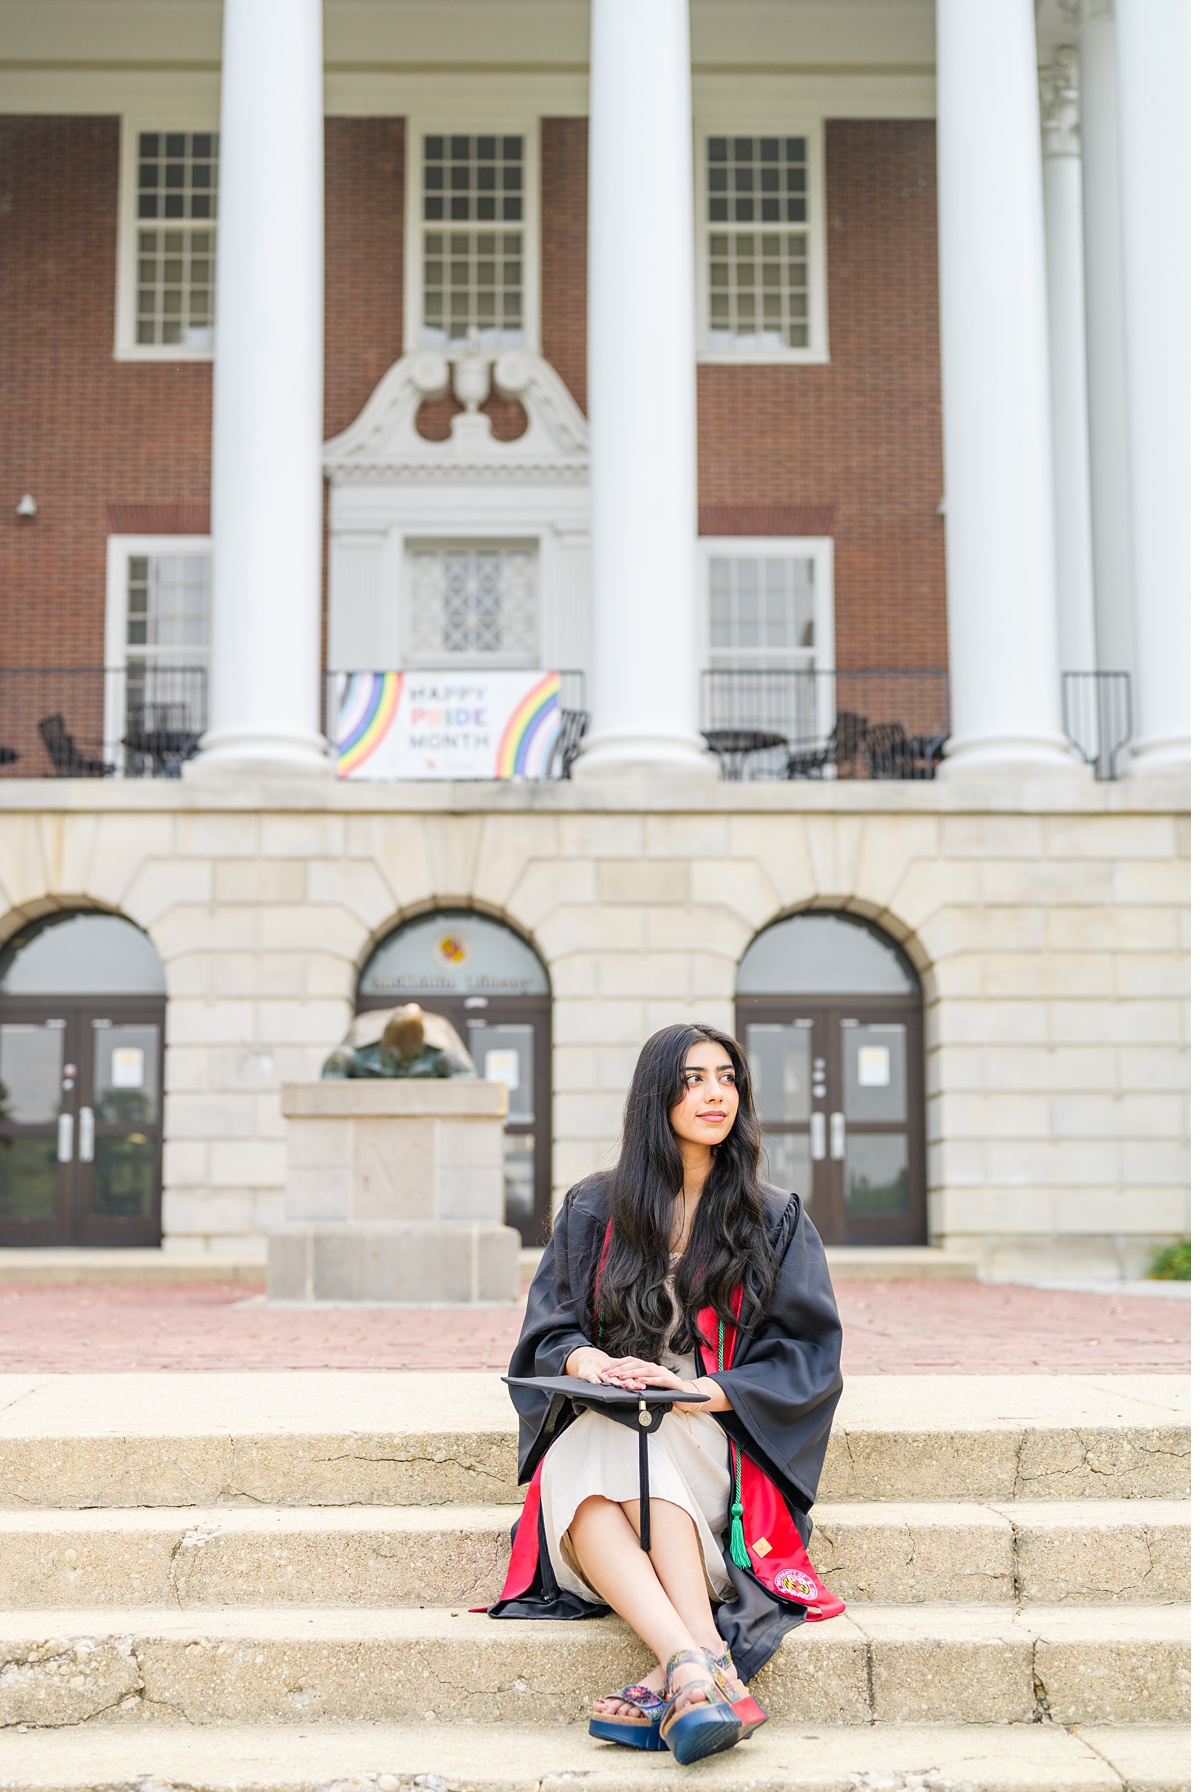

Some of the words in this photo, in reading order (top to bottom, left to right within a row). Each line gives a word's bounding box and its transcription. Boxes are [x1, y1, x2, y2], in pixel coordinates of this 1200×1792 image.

[409, 686, 488, 701] HAPPY
[410, 706, 487, 726] PRIDE
[408, 732, 490, 749] MONTH
